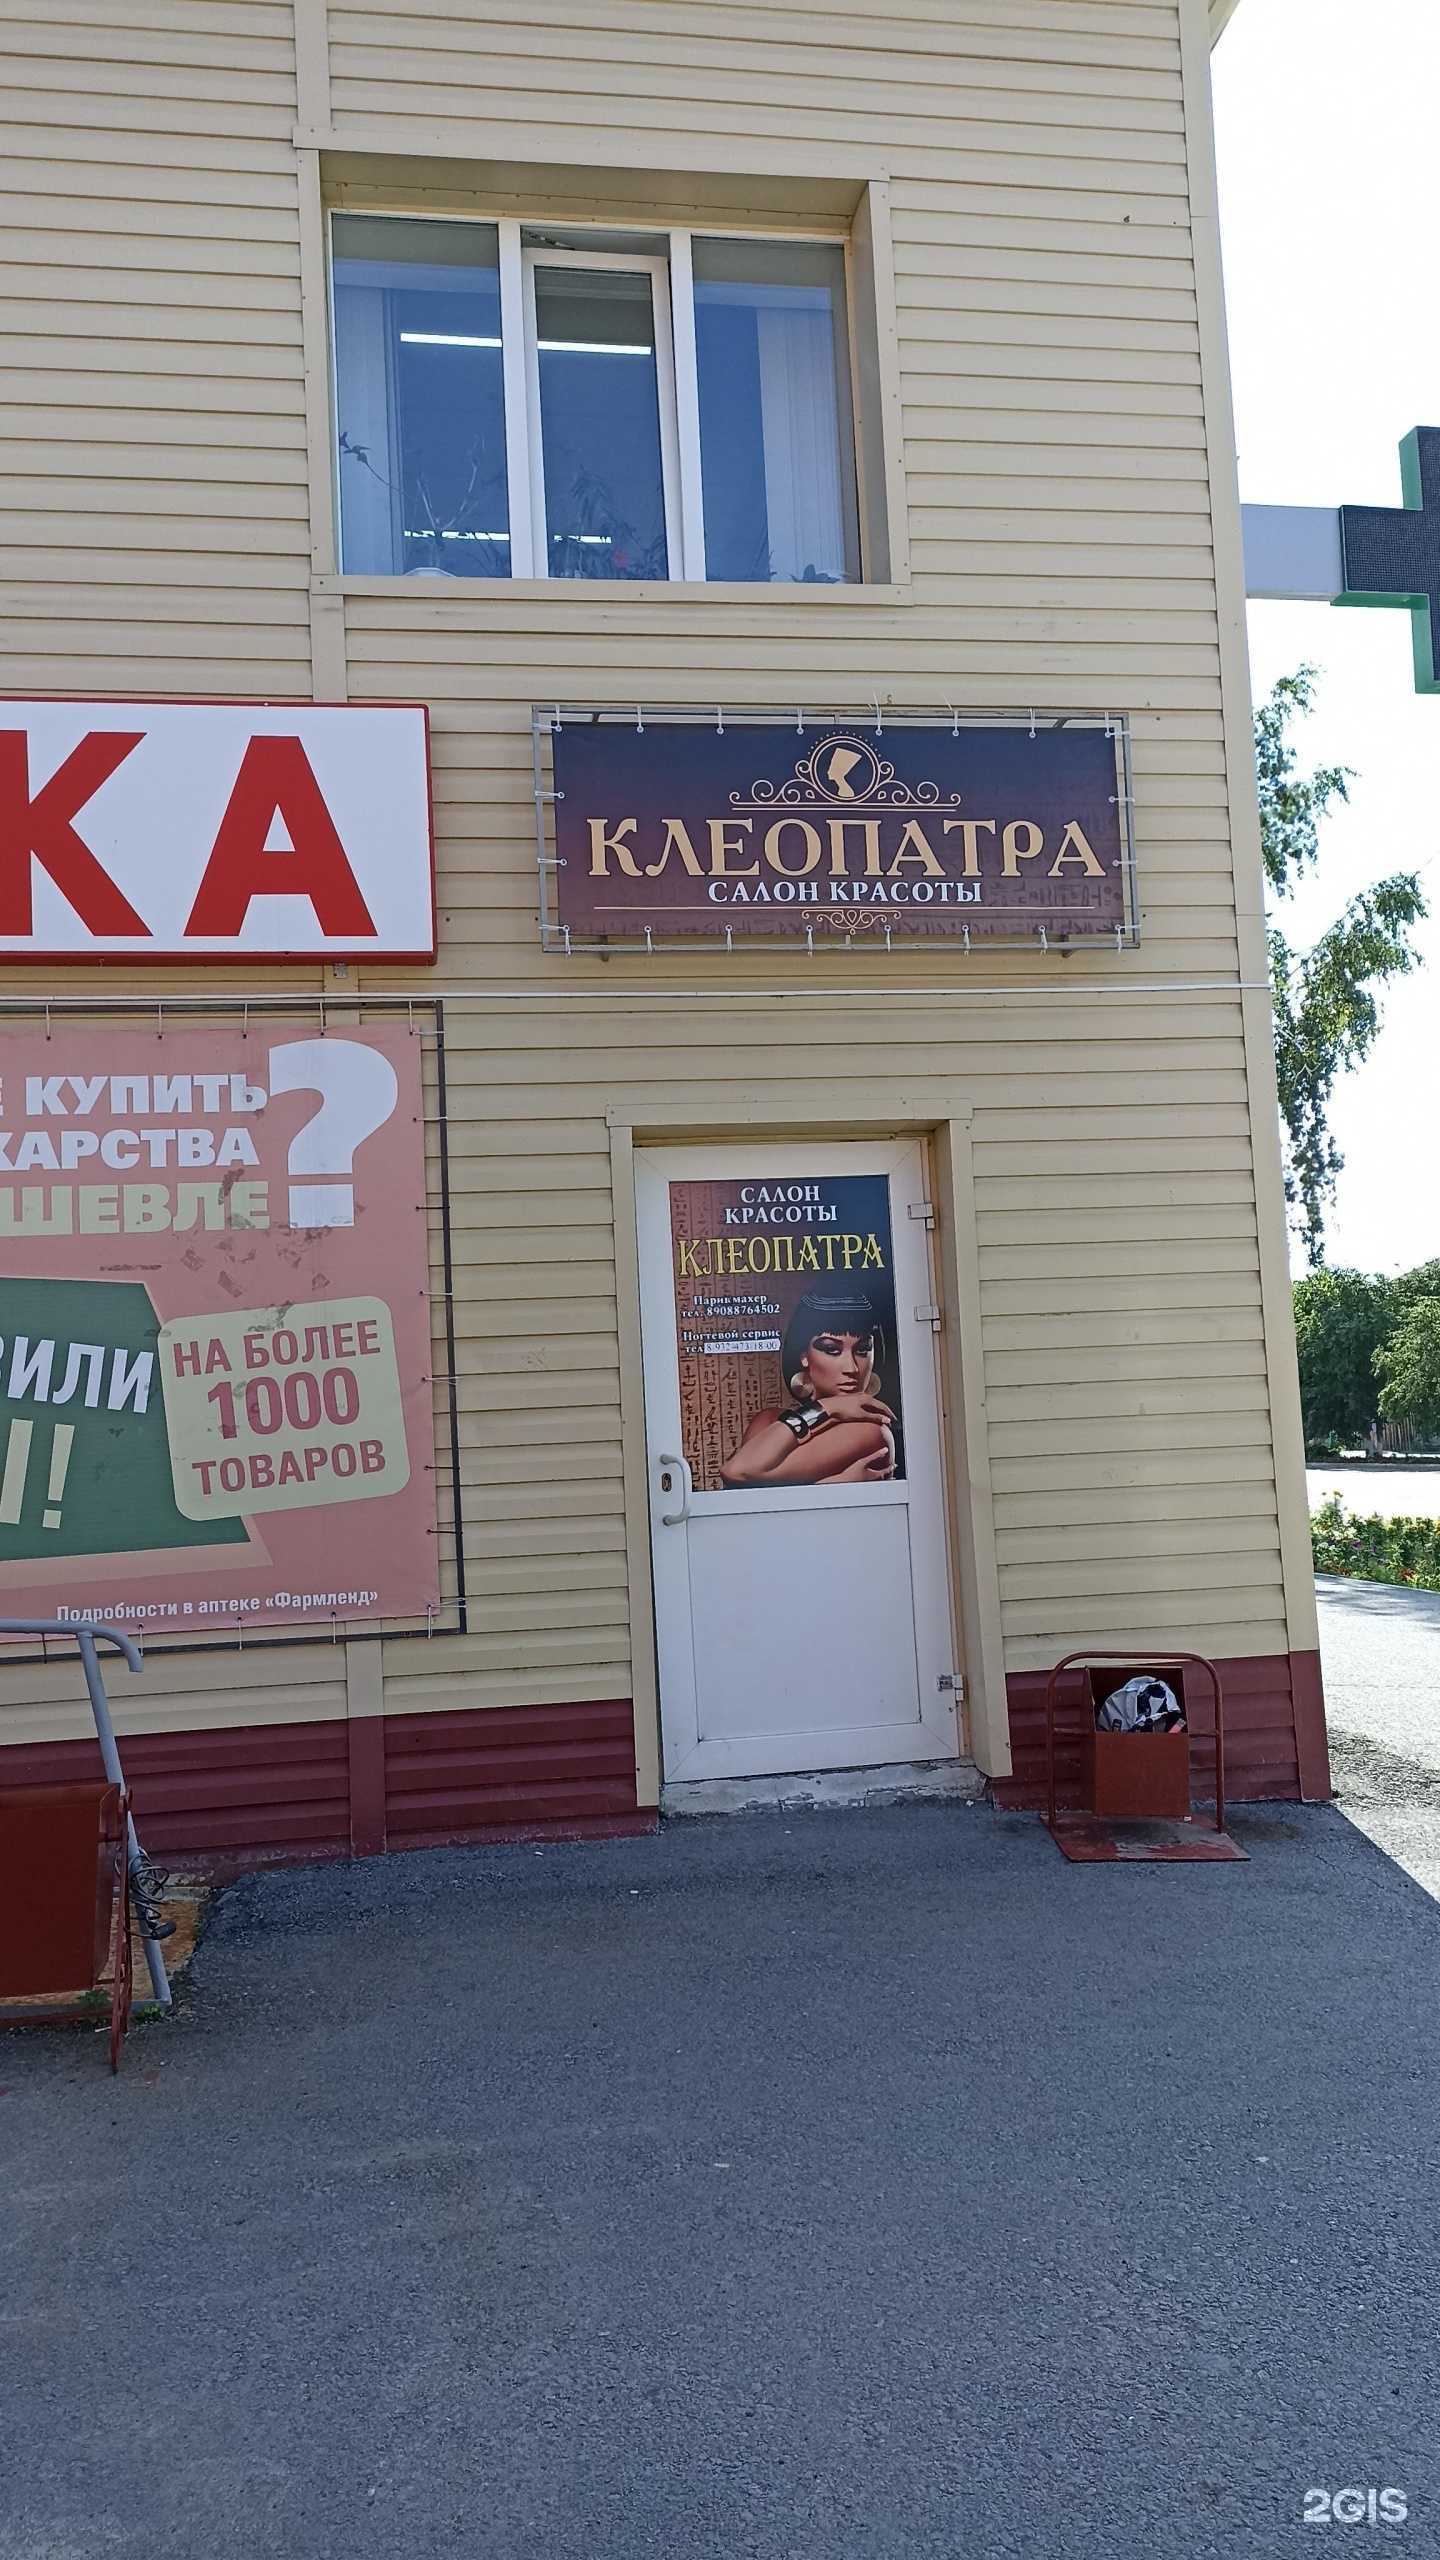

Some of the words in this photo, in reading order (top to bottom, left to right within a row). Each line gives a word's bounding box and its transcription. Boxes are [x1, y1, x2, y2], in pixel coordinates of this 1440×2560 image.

[586, 818, 1106, 877] КЛЕОПАТРА
[708, 881, 827, 903] САЛОН
[830, 881, 983, 903] КРАСОТЫ
[25, 1074, 268, 1116] КУПИТЬ
[724, 1205, 838, 1224] КРАСОТЫ
[741, 1185, 821, 1203] САЛОН
[677, 1233, 885, 1277] КЛЕОПАТРА
[693, 1295, 767, 1306] Парикмахер
[173, 1338, 232, 1377] НА
[244, 1320, 381, 1369] БОЛЕЕ
[683, 1330, 738, 1341] Ногтевой
[742, 1330, 780, 1340] сервис
[0, 1335, 154, 1414] ИЛИ
[207, 1367, 360, 1440] 1000
[192, 1439, 386, 1496] ТОВАРОВ
[57, 1602, 178, 1623] Подробности
[183, 1602, 192, 1614] в
[198, 1596, 260, 1613] аптеке
[265, 1590, 378, 1611] «Фармленд»
